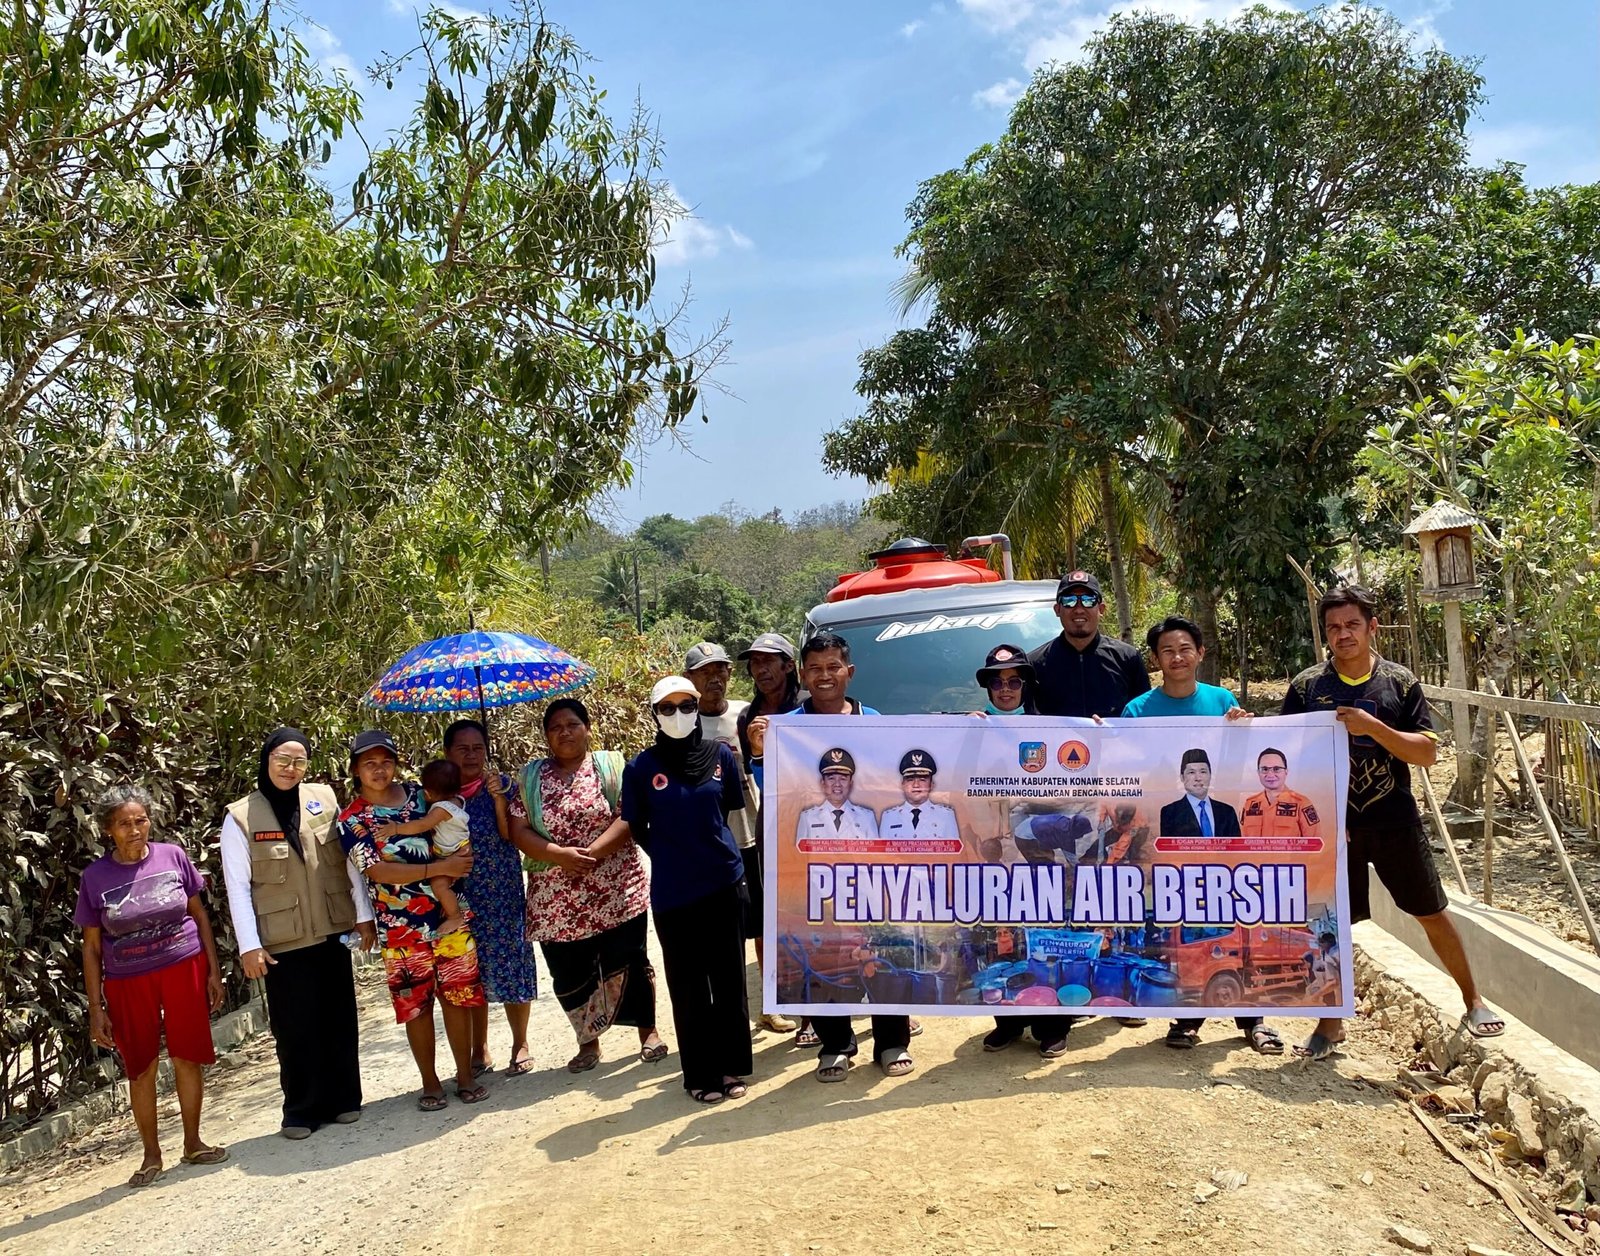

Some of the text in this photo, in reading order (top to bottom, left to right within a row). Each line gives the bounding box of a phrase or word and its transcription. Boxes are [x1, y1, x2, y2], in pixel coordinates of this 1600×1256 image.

[969, 777, 1140, 786] PEMERINTAH KABUPATEN KONAWE SELATAN
[967, 788, 1143, 798] BADAN PENANGGULANGAN BENCANA DAERAH
[807, 863, 1308, 926] PENYALURAN AIR BERSIH
[1040, 939, 1091, 949] PENYALURAN
